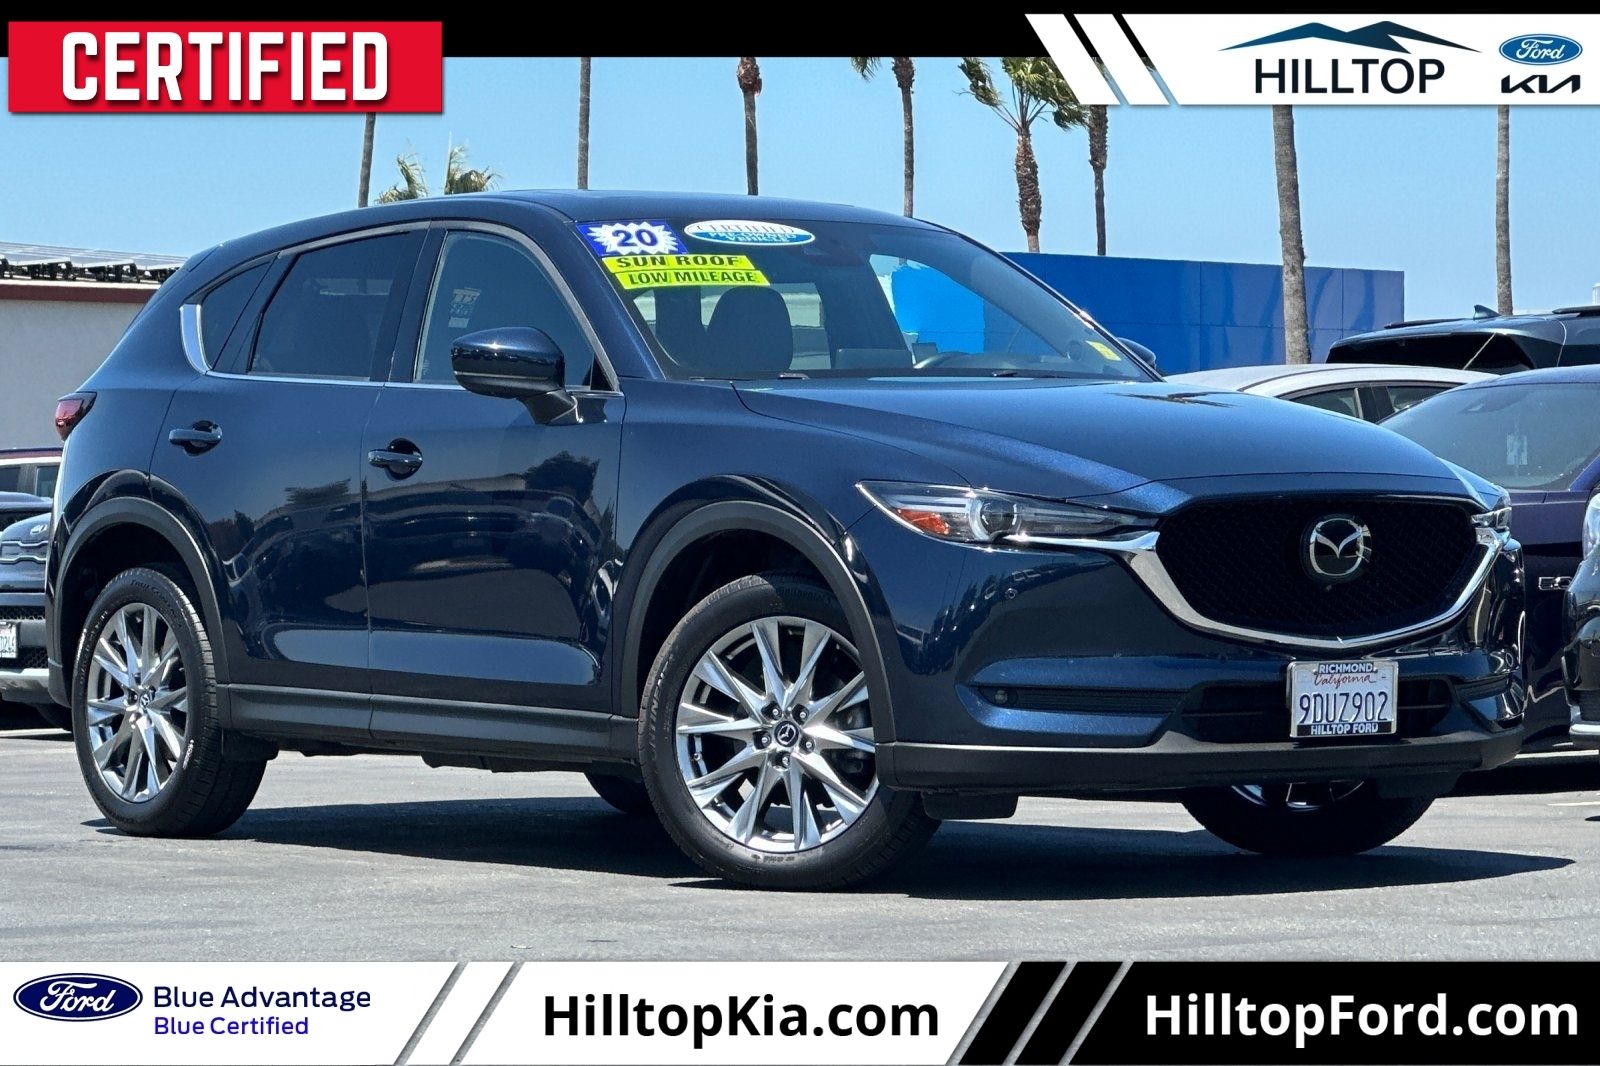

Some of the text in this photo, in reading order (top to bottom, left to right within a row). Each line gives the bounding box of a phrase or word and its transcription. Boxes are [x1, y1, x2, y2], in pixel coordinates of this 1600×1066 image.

[612, 229, 657, 247] 20
[617, 255, 739, 268] SUN ROOF
[628, 271, 756, 285] LOW MILEAGE
[1319, 663, 1373, 673] RICHMOND
[1315, 672, 1376, 689] California
[1299, 691, 1388, 723] 9DUZ902
[1311, 722, 1379, 735] HILLTOP FORD
